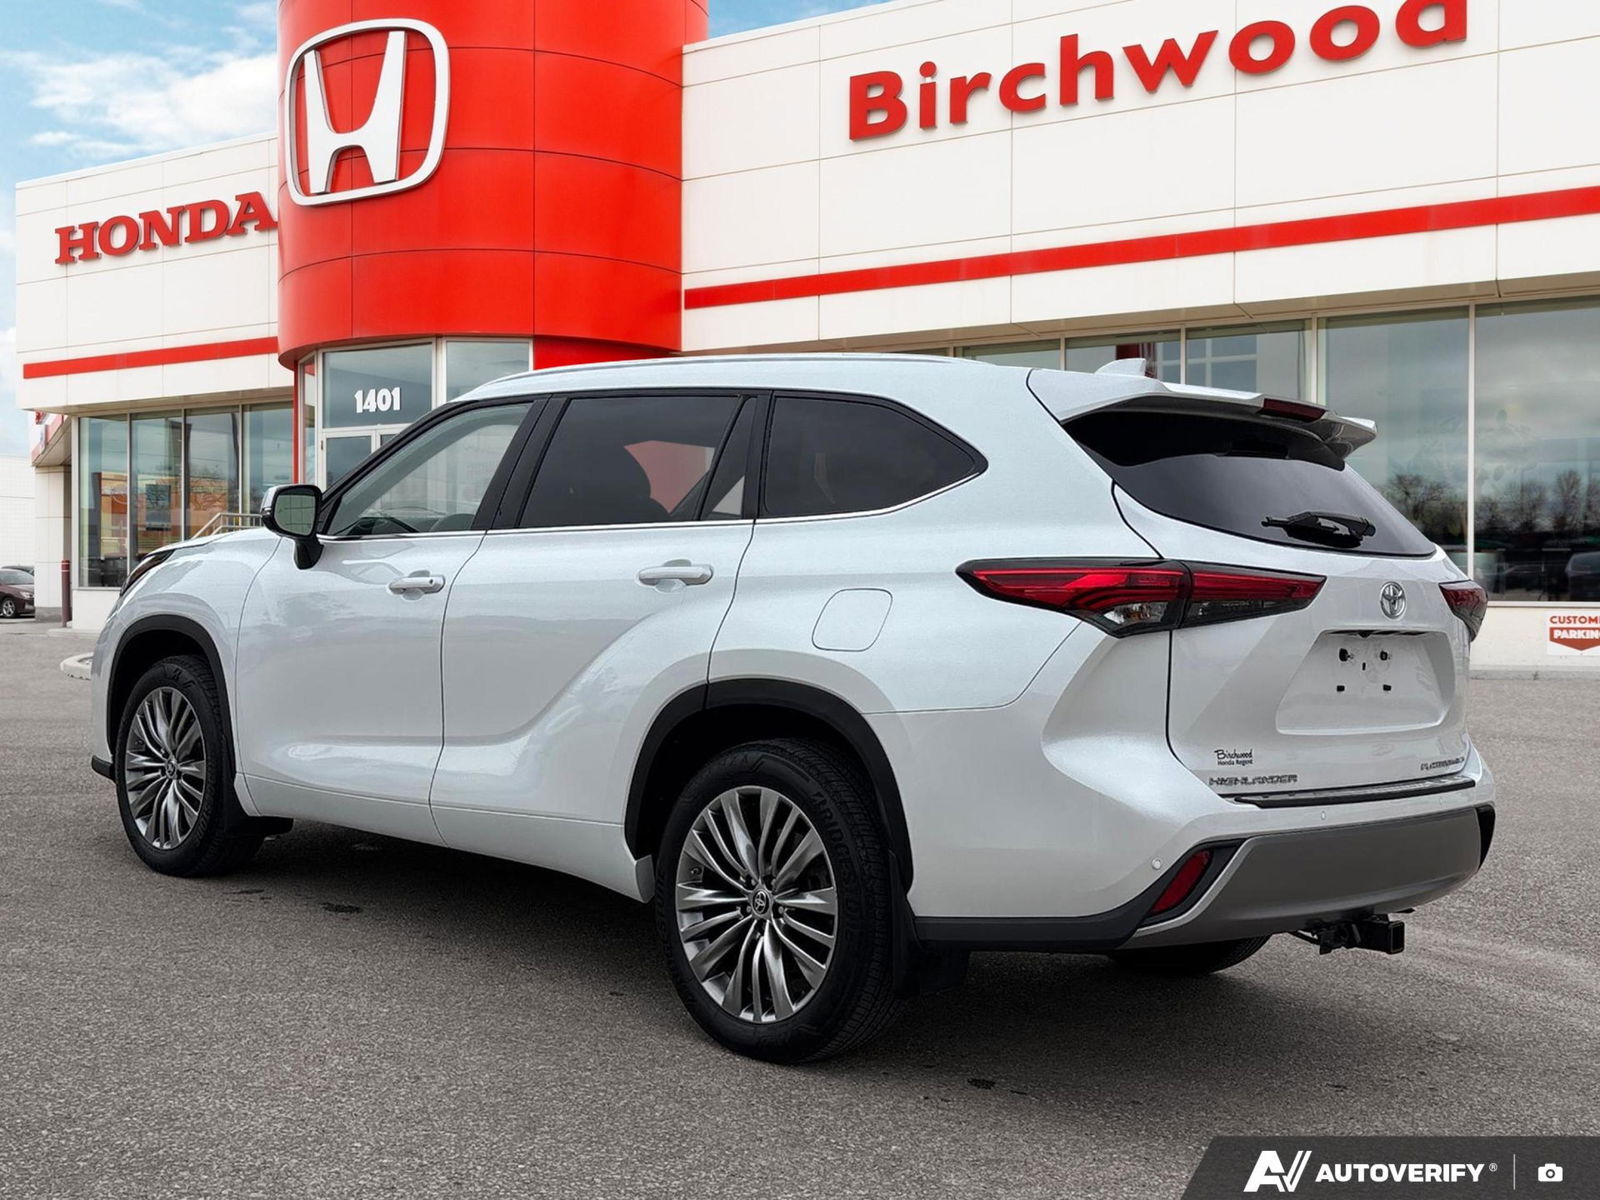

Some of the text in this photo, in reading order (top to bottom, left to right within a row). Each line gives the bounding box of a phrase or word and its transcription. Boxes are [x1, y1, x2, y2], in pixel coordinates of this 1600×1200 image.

[849, 0, 1468, 141] Birchwood
[55, 191, 278, 264] HONDA
[354, 387, 401, 413] 1401
[1550, 615, 1600, 624] CUSTOM
[1553, 629, 1600, 639] PARKIN
[1214, 748, 1253, 760] Birchwood
